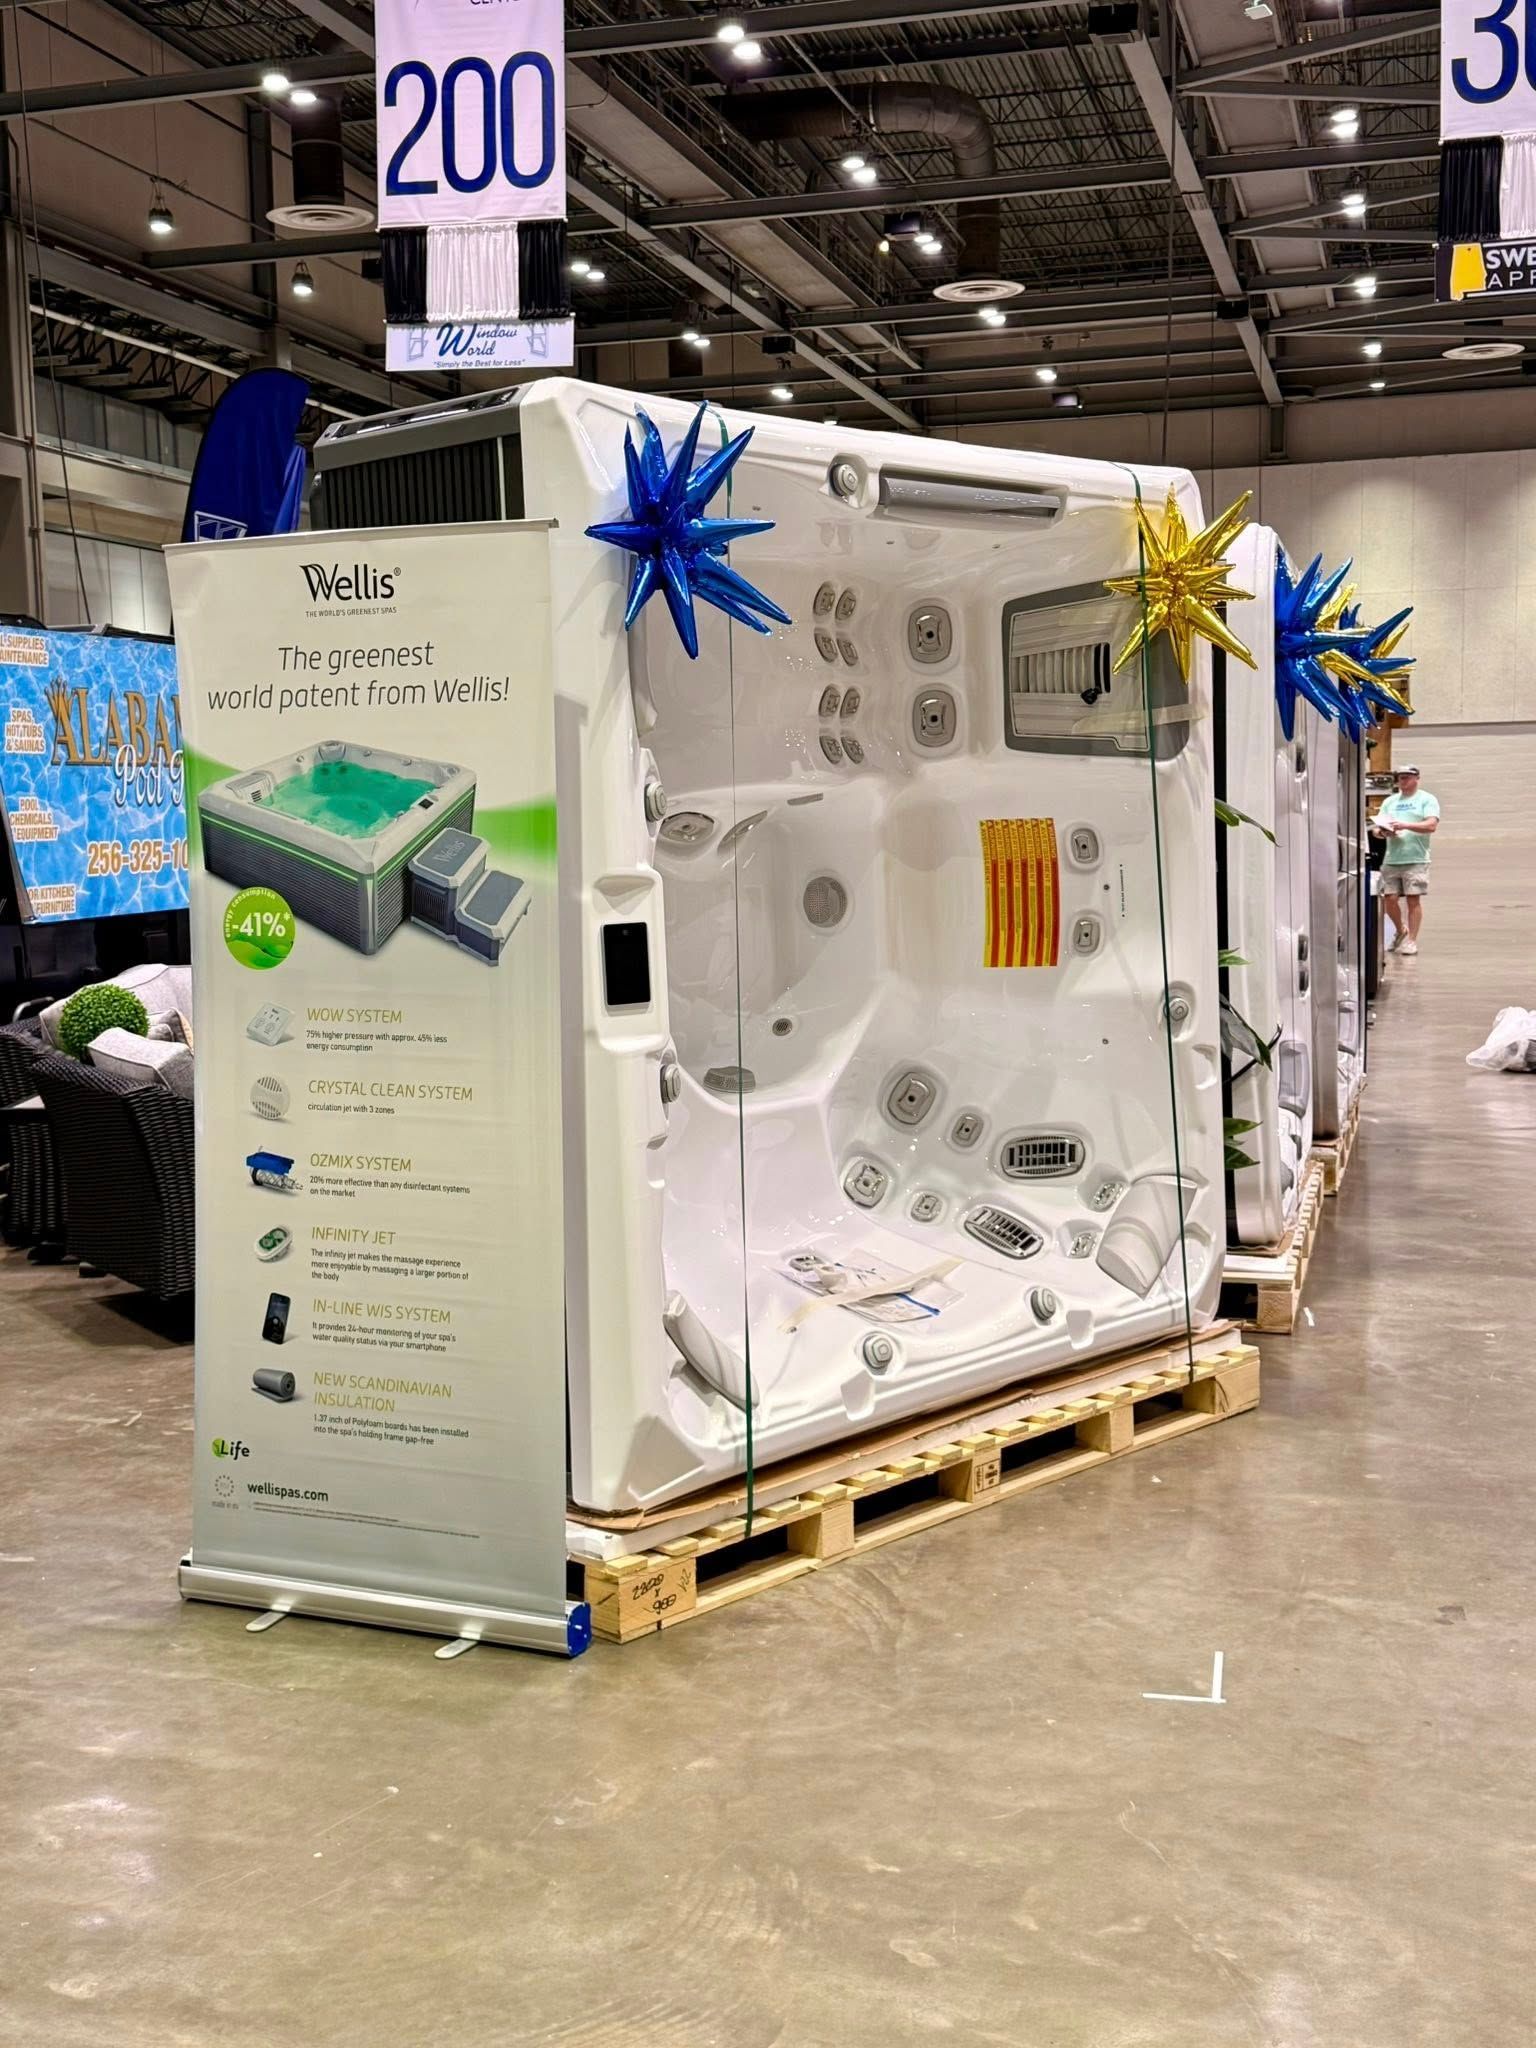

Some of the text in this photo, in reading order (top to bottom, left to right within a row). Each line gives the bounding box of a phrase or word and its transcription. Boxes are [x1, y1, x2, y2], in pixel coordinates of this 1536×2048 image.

[1451, 0, 1536, 104] 3
[384, 51, 555, 196] 200
[318, 609, 346, 617] WORLD'S
[347, 607, 380, 616] GREENEST
[381, 606, 397, 614] SPAS
[8, 635, 44, 651] SUPPLIES
[278, 641, 434, 676] The greenest
[208, 676, 510, 714] world patent from Wellis!
[6, 738, 44, 752] & SAUNAS
[115, 744, 163, 806] Pool
[20, 798, 38, 811] POOL
[10, 812, 52, 826] CHEMICALS
[16, 826, 58, 840] EQUIPMENT
[41, 886, 74, 900] KITCHENS
[306, 1007, 402, 1024] WOW SYSTEM
[306, 1030, 447, 1043] 75% higher pressure with approx. 45% less
[306, 1043, 373, 1052] energy consumption
[308, 1080, 473, 1100] CRYSTAL CLEAN SYSTEM
[308, 1103, 342, 1112] circulation
[343, 1105, 351, 1113] jet
[310, 1153, 411, 1172] OZMIX SYSTEM
[310, 1176, 324, 1184] 20%
[344, 1178, 372, 1188] effective
[374, 1180, 388, 1188] than
[403, 1182, 441, 1192] disinfectant
[443, 1186, 470, 1194] systems
[332, 1189, 355, 1197] market
[312, 1227, 396, 1245] INFINITY JET
[312, 1248, 461, 1268] The infinity jet makes the massage experience
[324, 1272, 339, 1282] body
[330, 1262, 361, 1272] enjoyable
[363, 1264, 370, 1273] by
[372, 1266, 408, 1276] massaging
[416, 1268, 435, 1278] larger
[437, 1271, 460, 1279] portion
[462, 1272, 469, 1280] of
[313, 1299, 451, 1324] IN-LINE WIS SYSTEM
[319, 1322, 346, 1332] provides
[348, 1324, 374, 1334] 24-hour
[376, 1328, 412, 1339] monitoring
[414, 1330, 420, 1338] of
[422, 1333, 436, 1342] your
[438, 1334, 456, 1342] spa's
[333, 1335, 355, 1345] quality
[356, 1338, 377, 1346] status
[406, 1342, 446, 1352] smartphone
[313, 1372, 452, 1398] NEW SCANDINAVIAN
[314, 1392, 395, 1412] INSULATION
[314, 1426, 326, 1434] into
[340, 1428, 357, 1437] spa's
[358, 1430, 382, 1441] holding
[384, 1432, 404, 1442] frame
[406, 1435, 434, 1445] gap-free
[329, 1416, 342, 1424] inch
[352, 1418, 383, 1428] Polyfoam
[385, 1421, 407, 1431] boards
[409, 1424, 421, 1432] has
[423, 1425, 439, 1435] been
[441, 1428, 469, 1438] installed
[247, 1481, 328, 1502] wellispas.com
